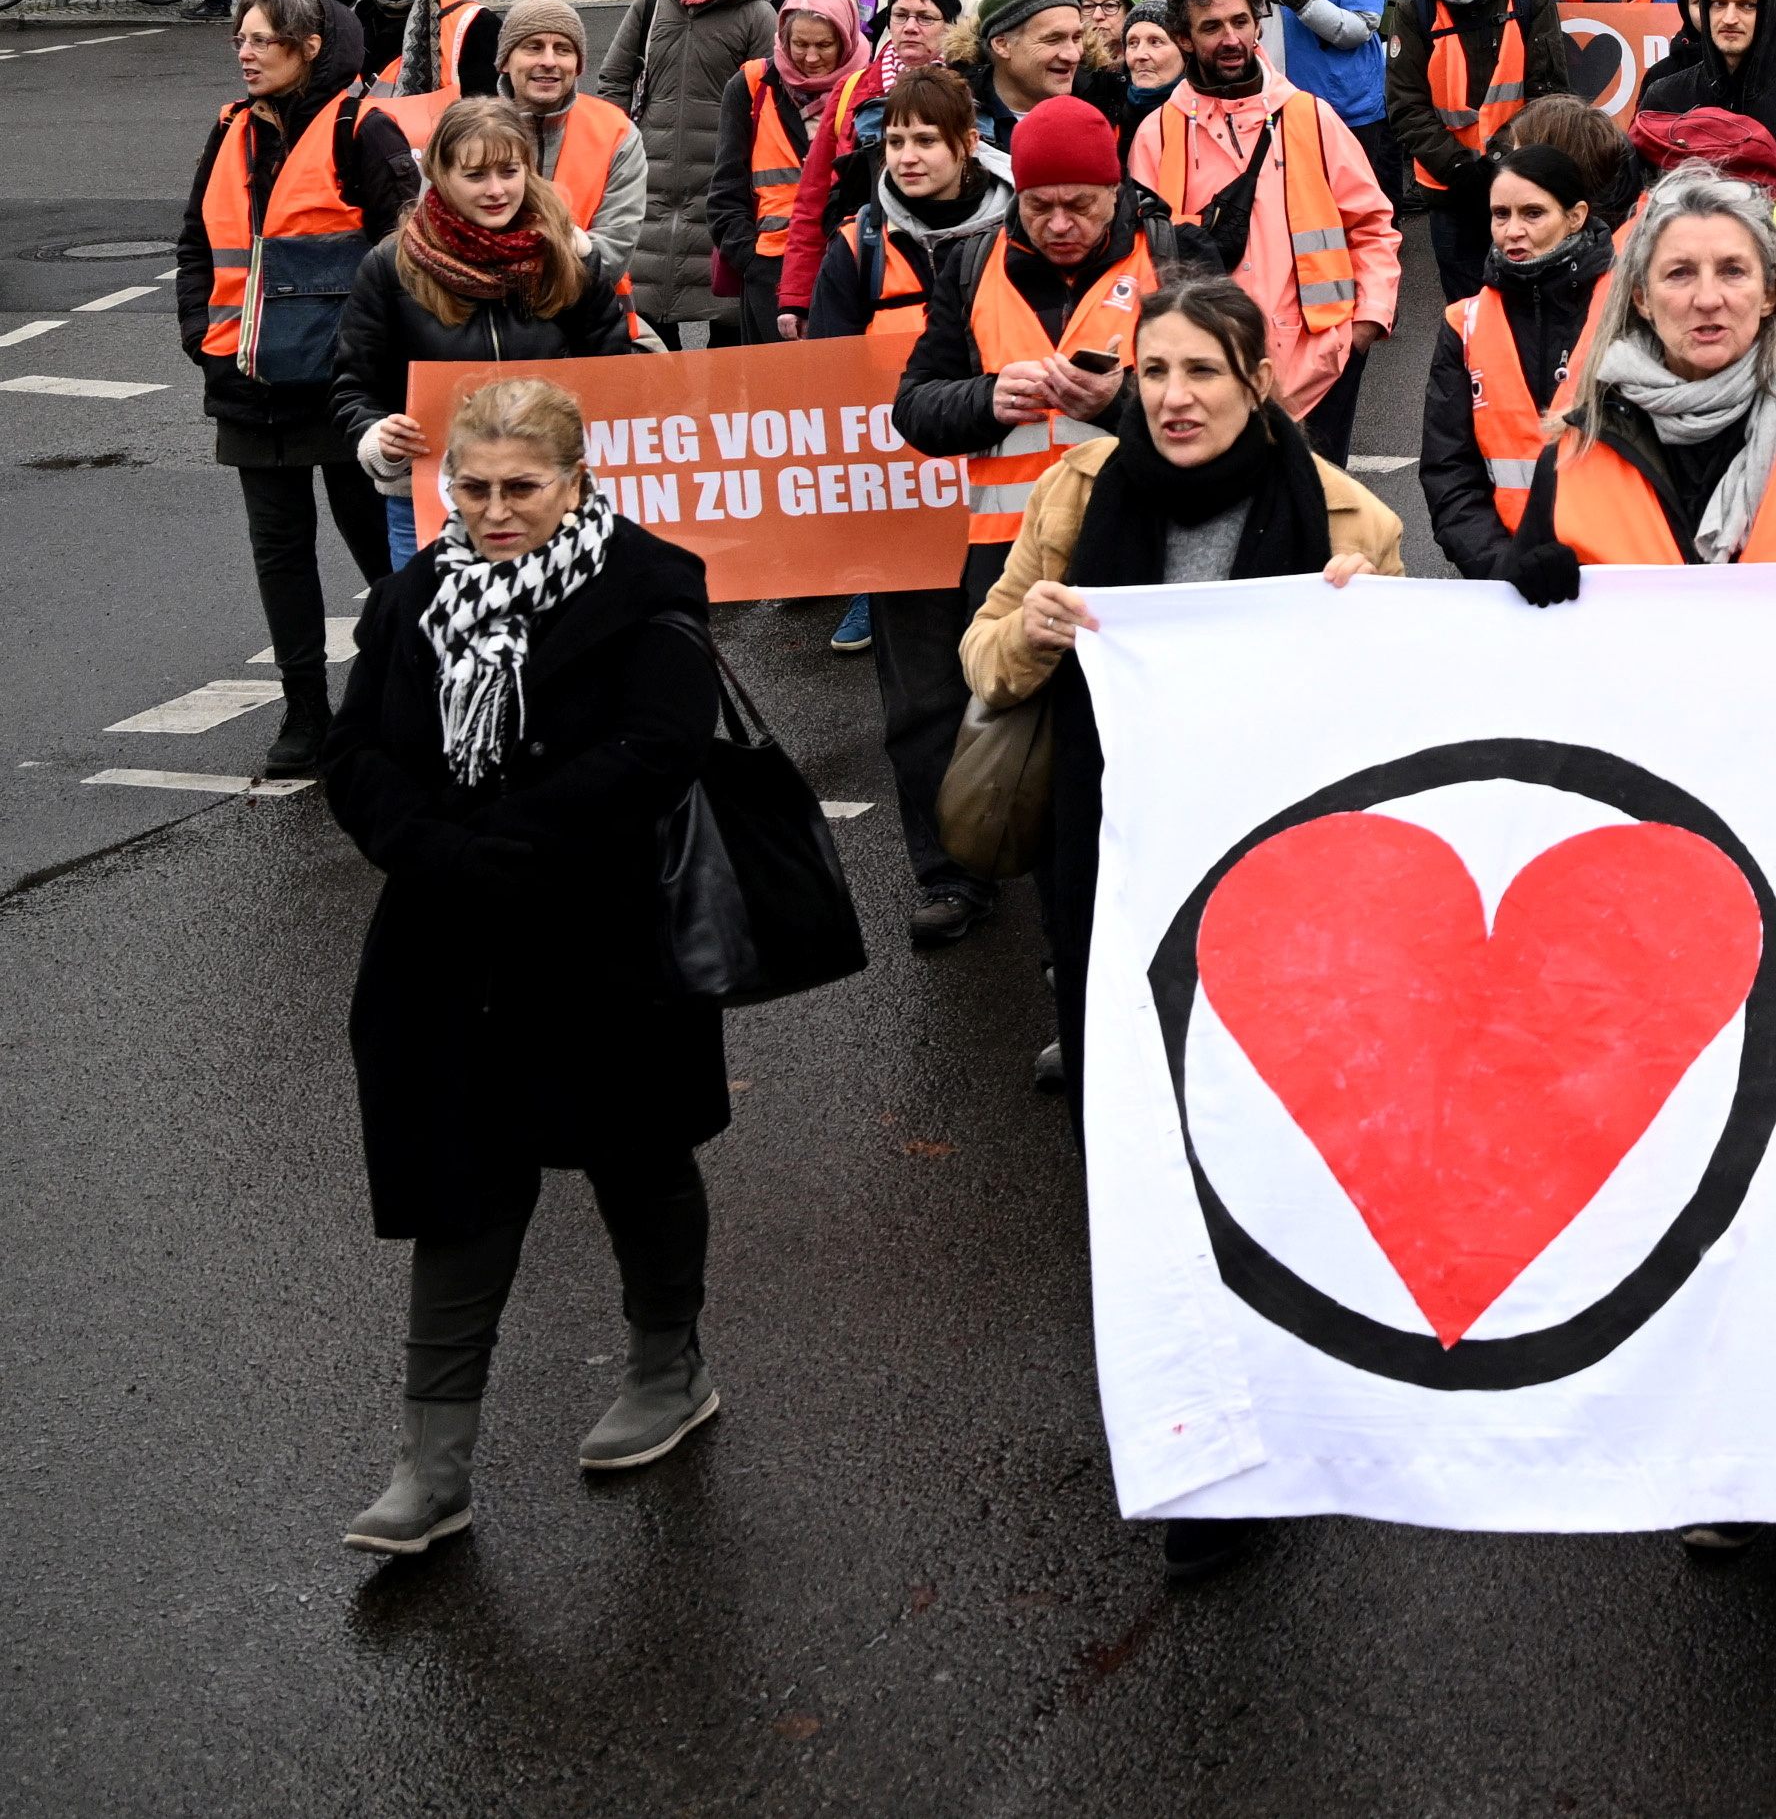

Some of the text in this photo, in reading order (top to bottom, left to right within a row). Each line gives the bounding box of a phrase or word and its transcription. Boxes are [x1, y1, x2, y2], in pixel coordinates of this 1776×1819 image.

[587, 404, 905, 467] WEG VON FO
[693, 469, 762, 521] ZU
